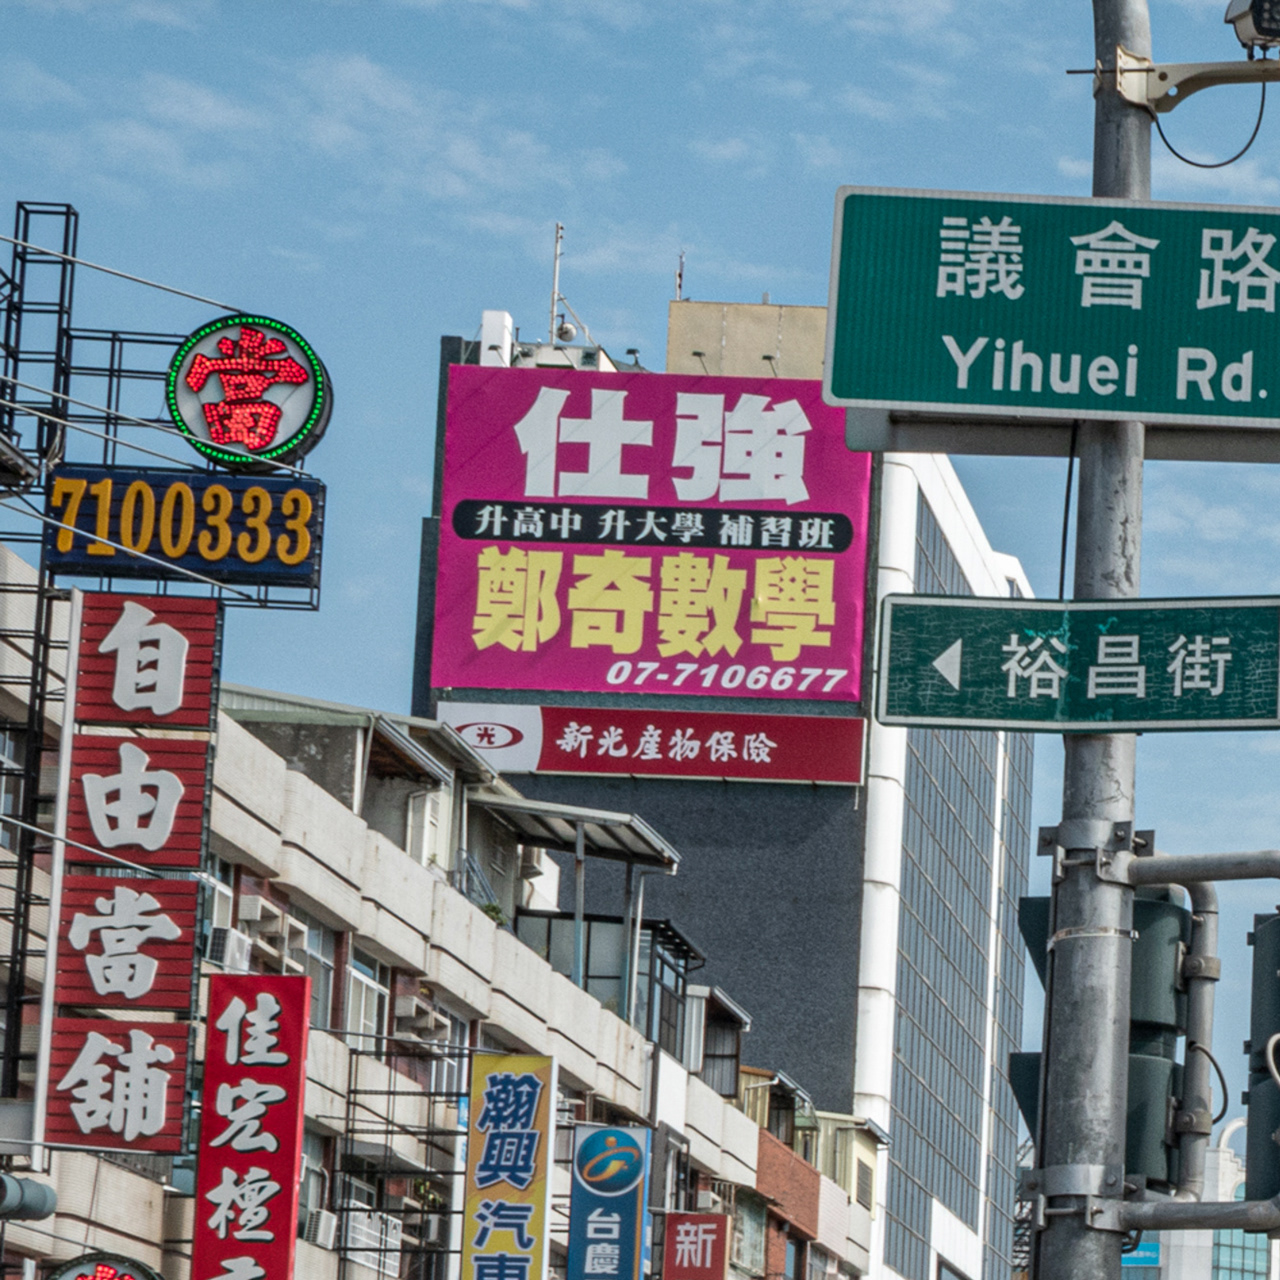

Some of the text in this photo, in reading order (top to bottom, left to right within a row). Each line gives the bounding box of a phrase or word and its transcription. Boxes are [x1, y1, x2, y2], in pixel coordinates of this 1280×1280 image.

[187, 326, 309, 449] 當
[941, 335, 1268, 402] Yihuei Rd.
[514, 387, 812, 505] 仕強
[51, 477, 312, 565] 7100333
[474, 505, 835, 550] 升高中 升大學 補習班
[472, 546, 836, 661] 鄭奇數學
[606, 661, 848, 692] 07-7106677
[1001, 633, 1232, 699] 裕昌街
[56, 600, 189, 1142] 自由當舖
